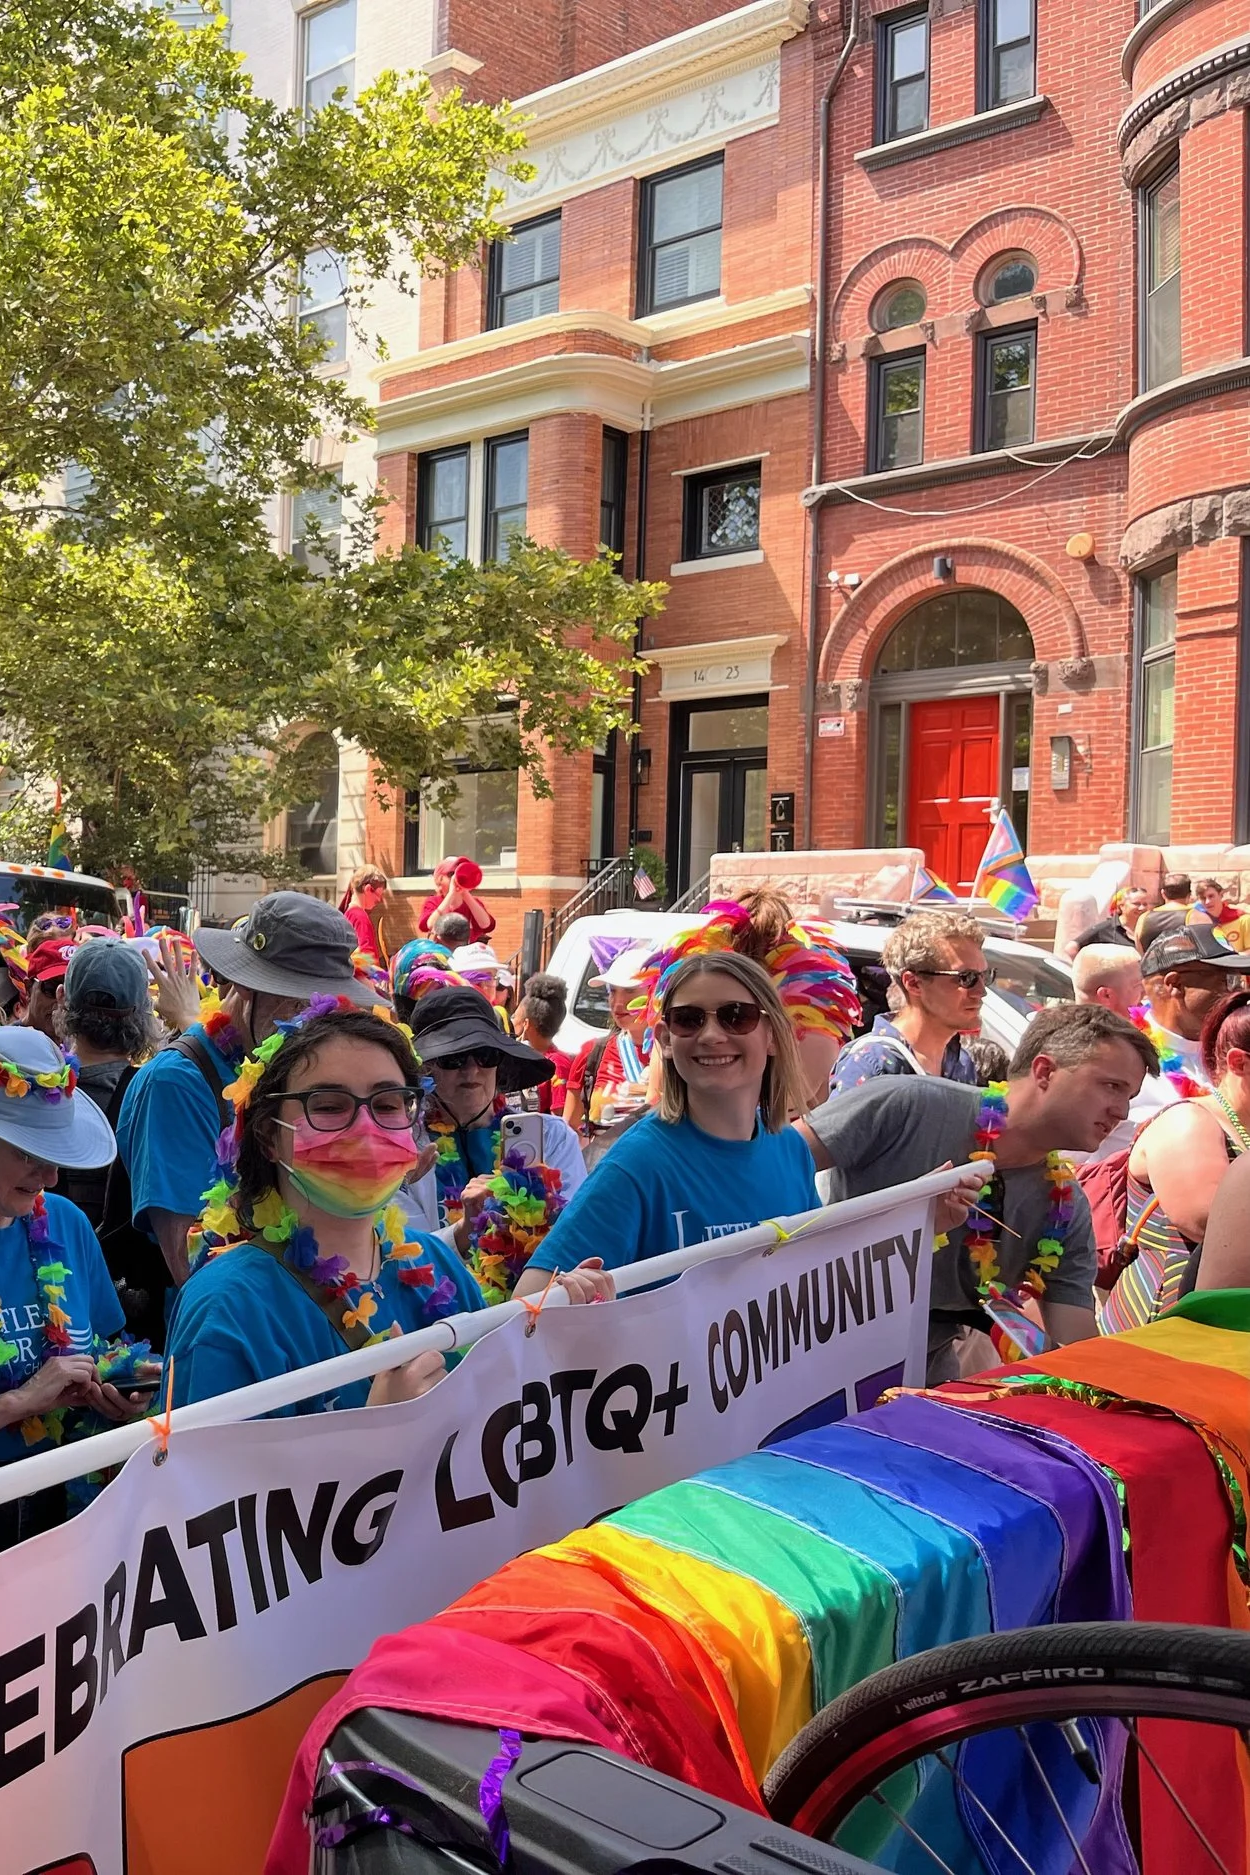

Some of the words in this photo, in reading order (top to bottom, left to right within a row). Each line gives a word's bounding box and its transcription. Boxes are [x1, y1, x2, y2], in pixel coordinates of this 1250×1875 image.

[693, 668, 705, 683] 14
[725, 665, 740, 680] 23
[708, 1229, 922, 1413] COMMUNITY
[902, 1690, 947, 1710] vittoria
[958, 1667, 1104, 1694] ZAFFIRO
